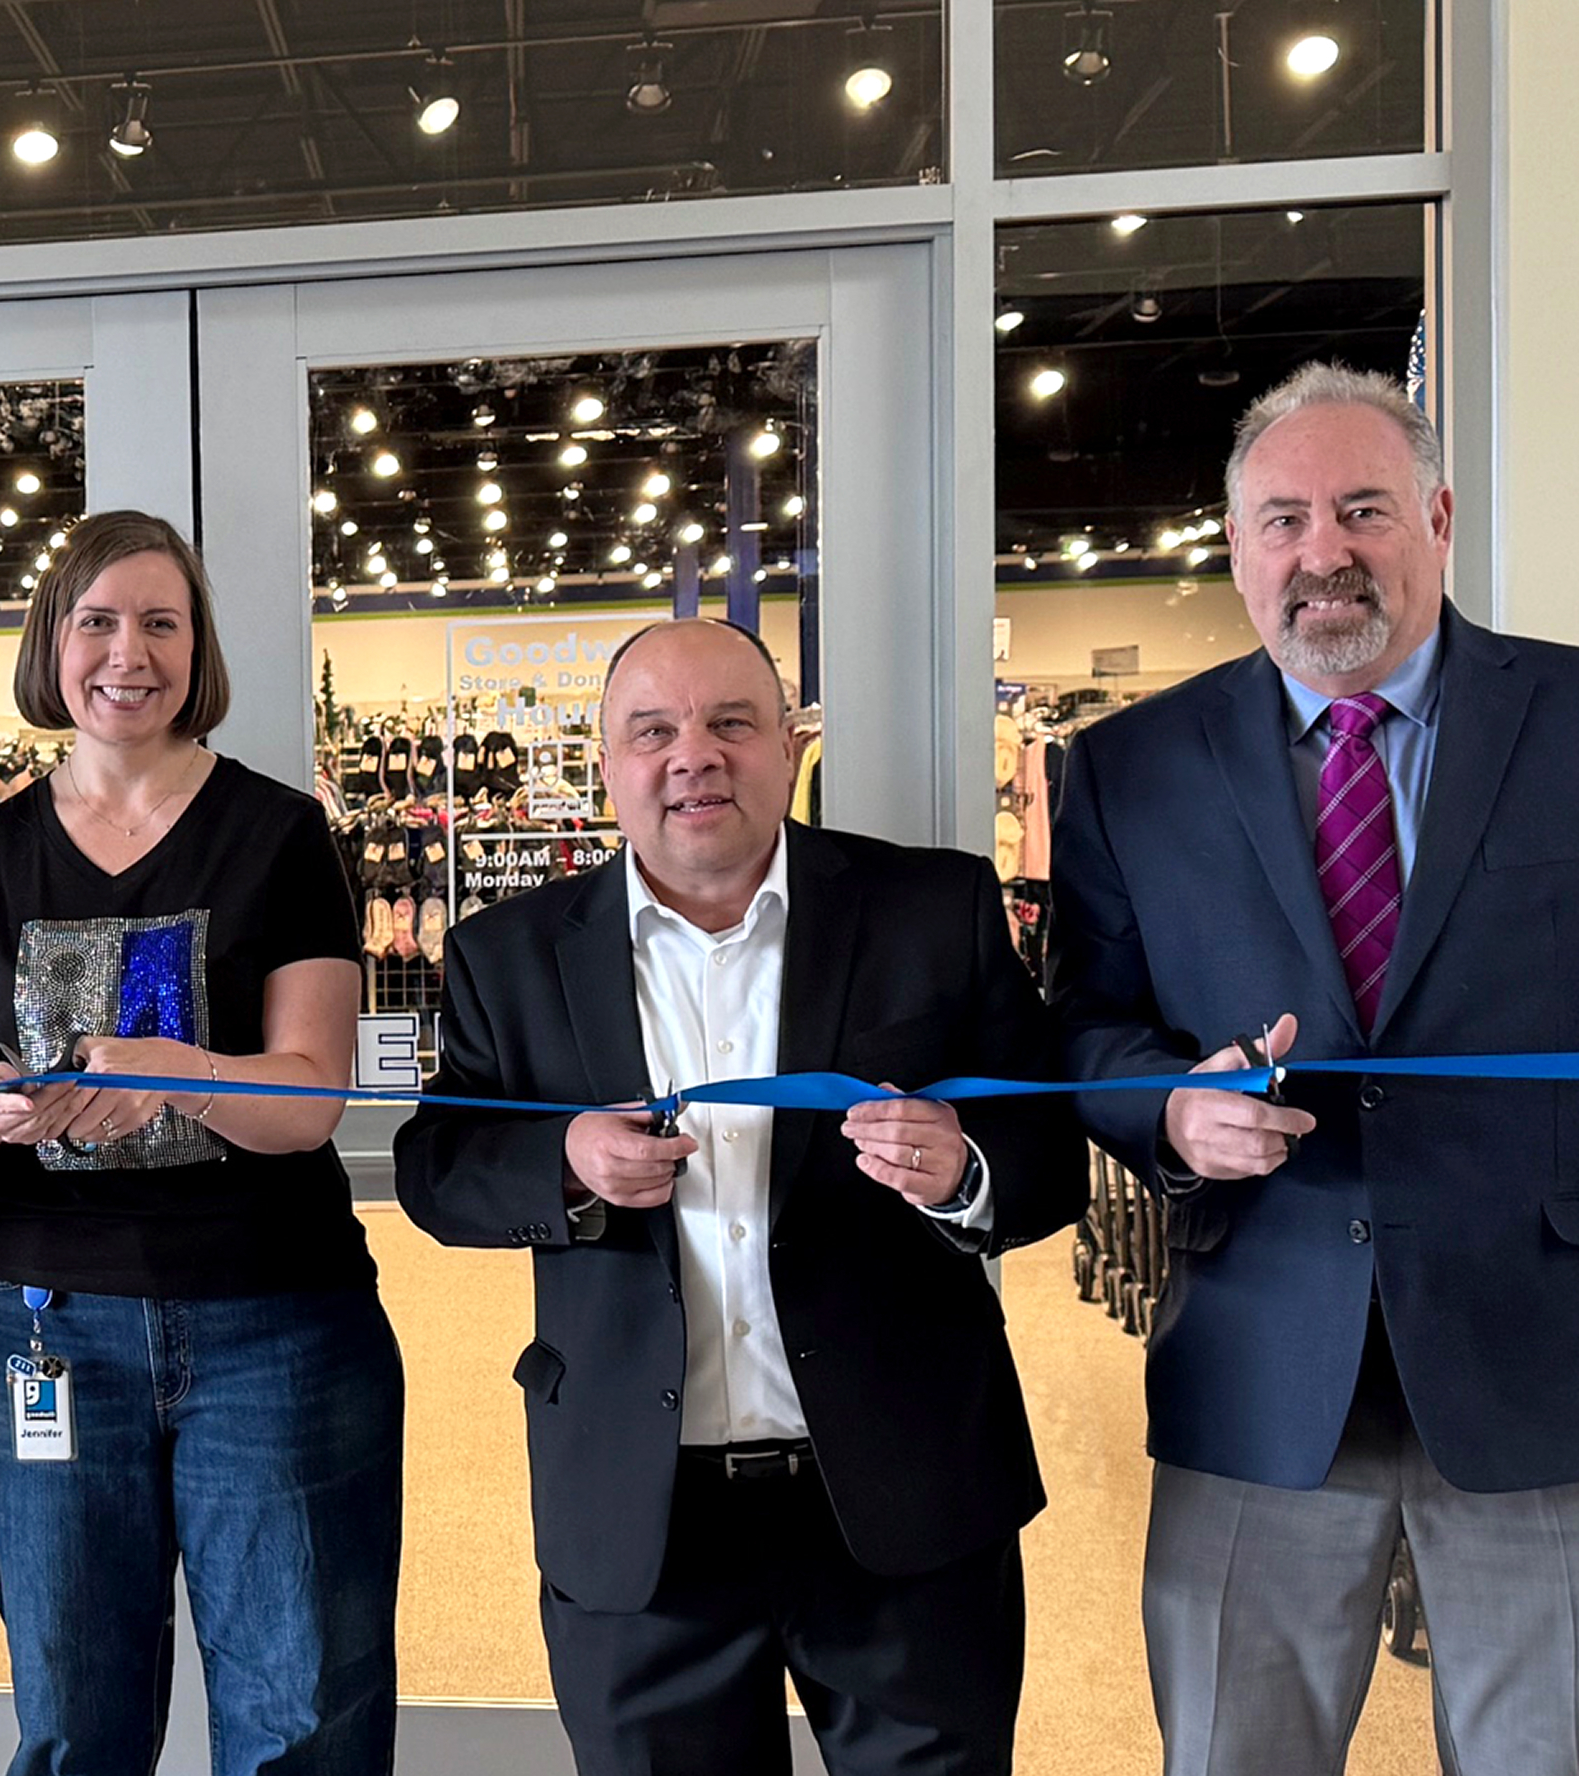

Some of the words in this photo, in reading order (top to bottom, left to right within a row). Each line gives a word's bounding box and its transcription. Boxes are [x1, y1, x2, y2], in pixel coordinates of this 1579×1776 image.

[465, 632, 624, 667] Goodw
[459, 674, 522, 691] Store
[557, 670, 602, 688] Don
[497, 697, 602, 729] Hour
[475, 850, 551, 868] 9:00AM
[572, 849, 617, 866] 8:00
[465, 871, 545, 889] Monday
[352, 1012, 423, 1092] E
[21, 1429, 63, 1439] Jennifer
